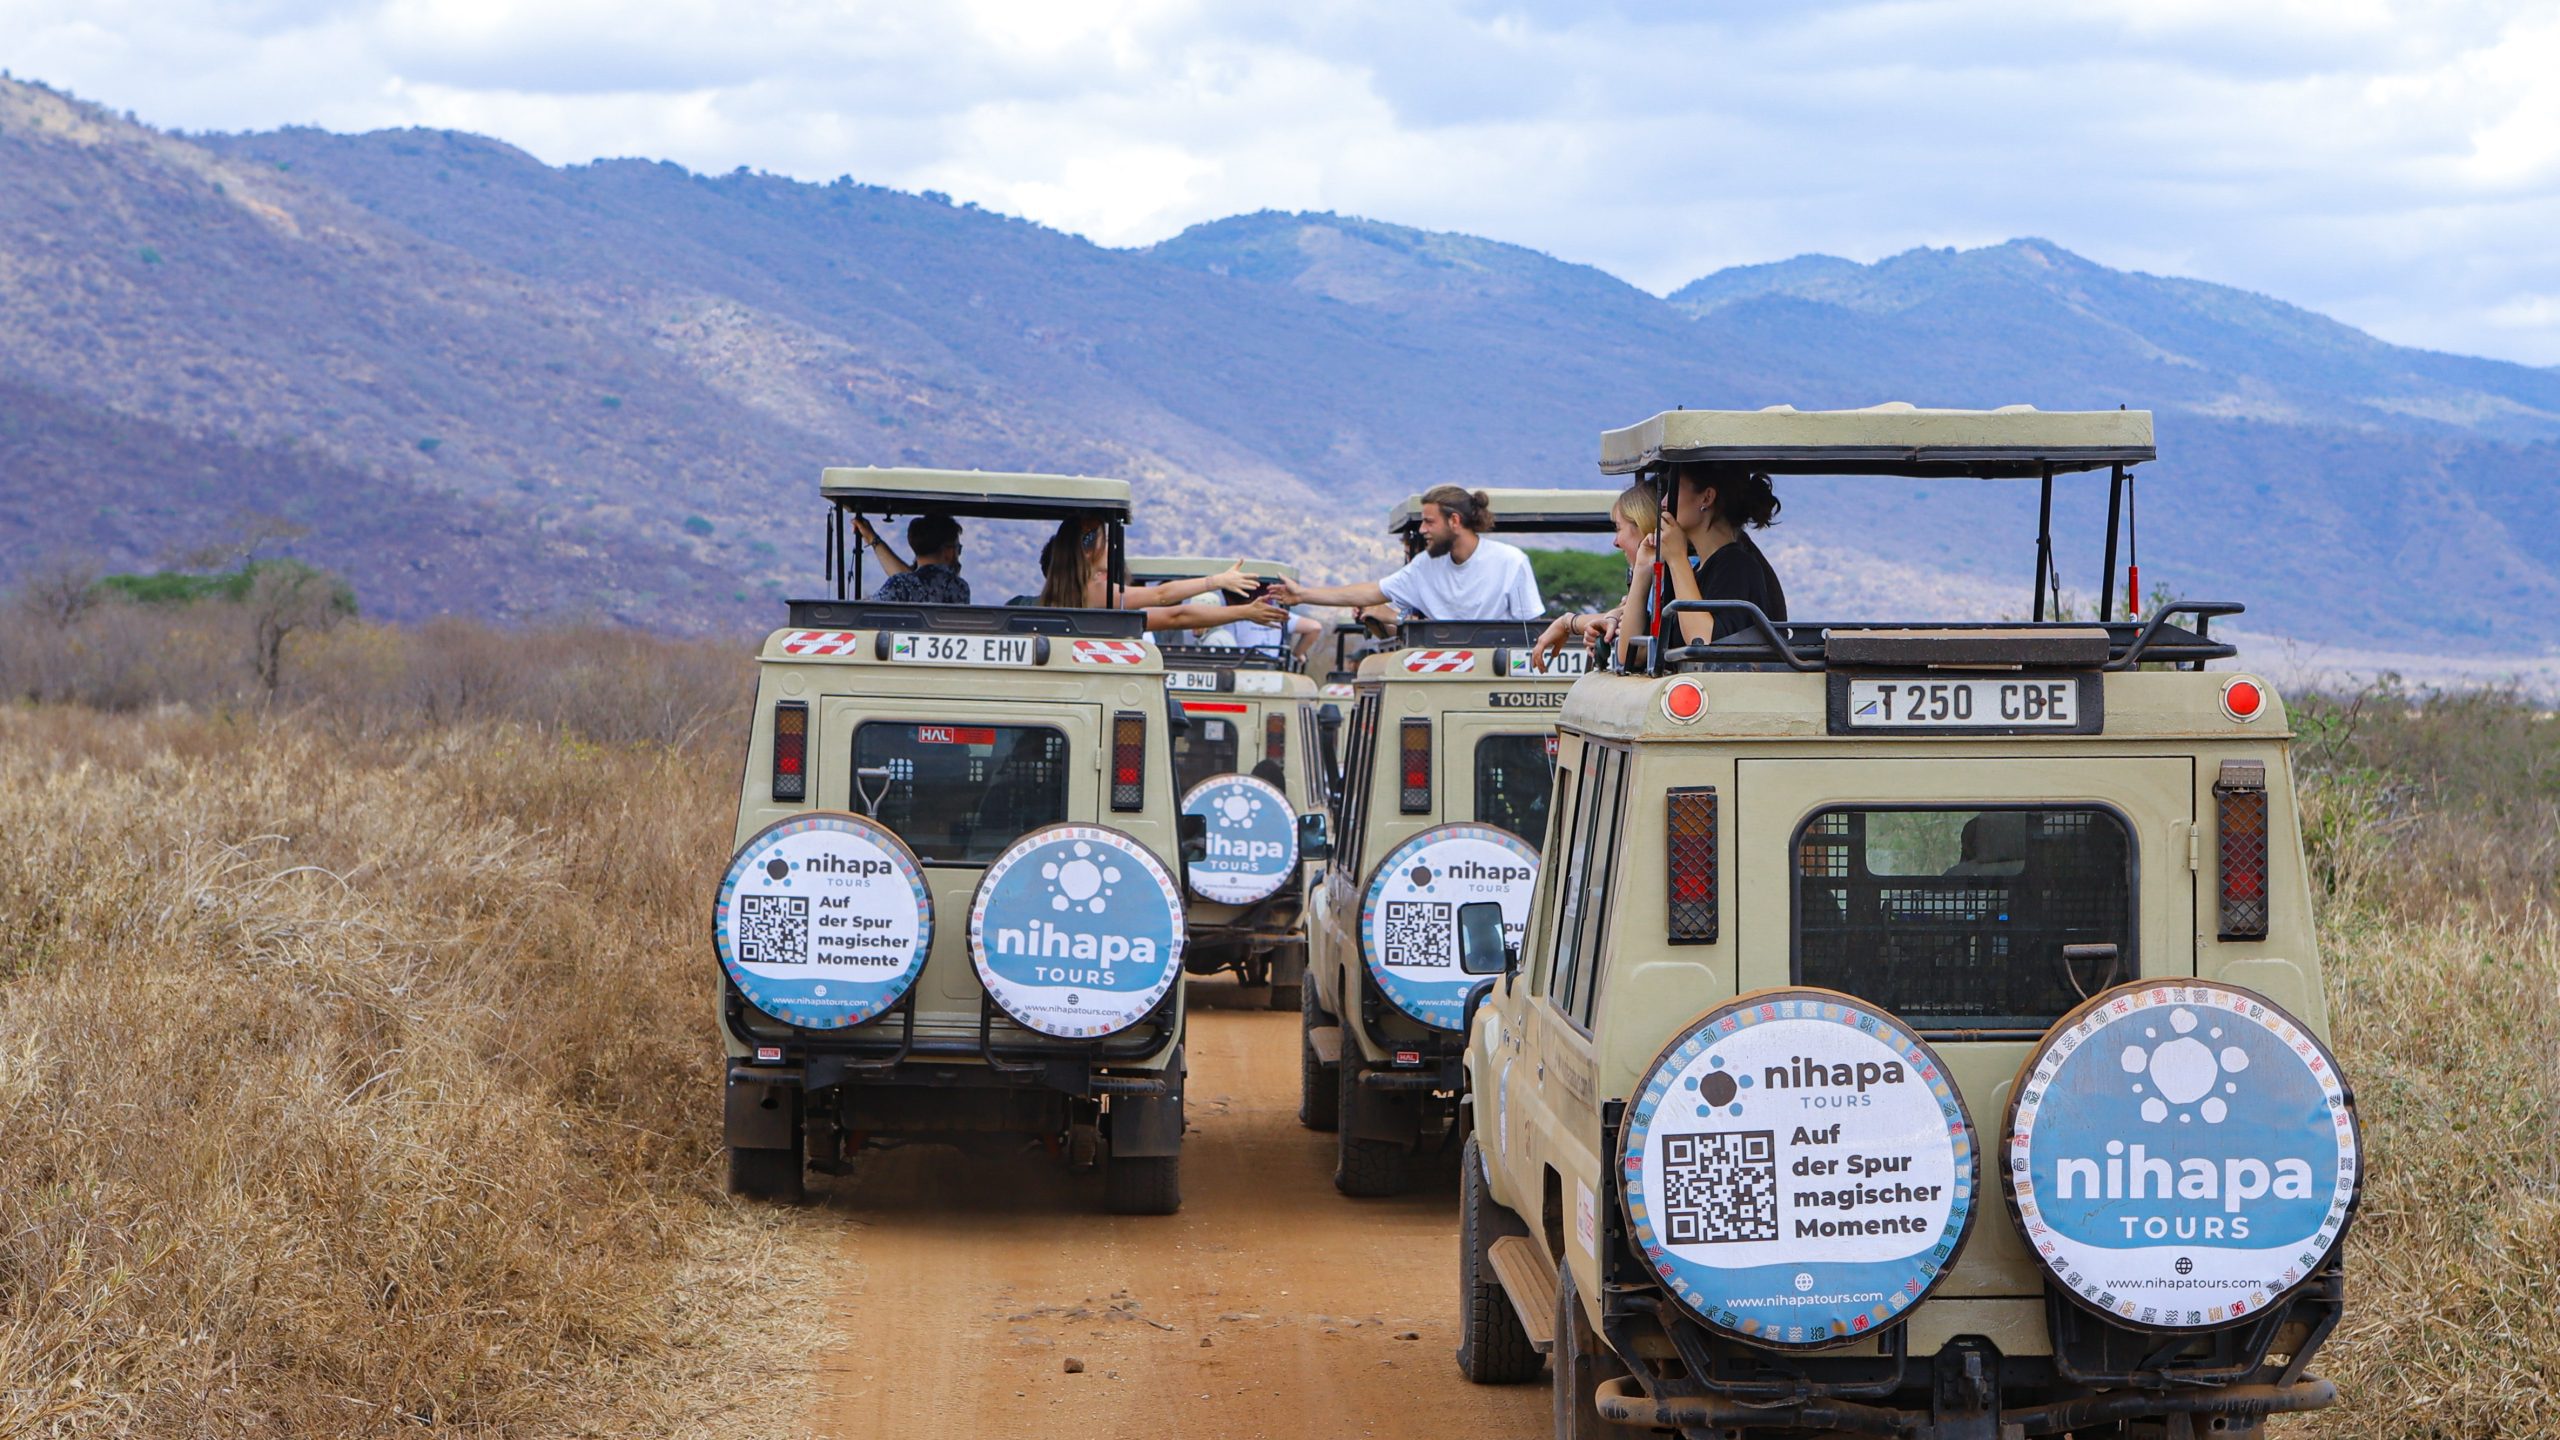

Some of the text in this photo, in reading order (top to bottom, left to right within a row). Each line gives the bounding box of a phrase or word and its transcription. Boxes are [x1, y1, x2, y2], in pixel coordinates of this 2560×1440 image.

[908, 636, 1026, 662] T 362 EHV
[1497, 693, 1567, 707] TOURIS
[1877, 684, 2067, 720] T 250 CBE
[921, 729, 950, 741] HAL
[1205, 832, 1284, 862] ihapa
[806, 853, 892, 878] nihapa
[1210, 860, 1260, 872] TOURS
[1449, 860, 1531, 884] nihapa
[827, 878, 871, 888] TOURS
[1469, 884, 1511, 893] TOURS
[820, 896, 850, 908] Auf
[818, 915, 892, 931] der Spur
[1504, 923, 1524, 934] pu
[818, 933, 909, 949] magischer
[997, 919, 1156, 969] nihapa
[817, 953, 899, 966] Momente
[1035, 966, 1115, 985] TOURS
[772, 997, 869, 1007] www.nihapatours.com
[1024, 1004, 1121, 1017] www.nihapatours.com
[1764, 1055, 1904, 1092] nihapa
[1800, 1094, 1871, 1109] TOURS
[1791, 1124, 1840, 1145] Auf
[1792, 1153, 1912, 1178] der Spur
[2056, 1140, 2312, 1213] nihapa
[1794, 1183, 1941, 1210] magischer
[1795, 1213, 1927, 1238] Momente
[2120, 1216, 2250, 1239] TOURS
[2105, 1277, 2261, 1290] www.nihapatours.com
[1726, 1290, 1883, 1308] www.nihapatours.com
